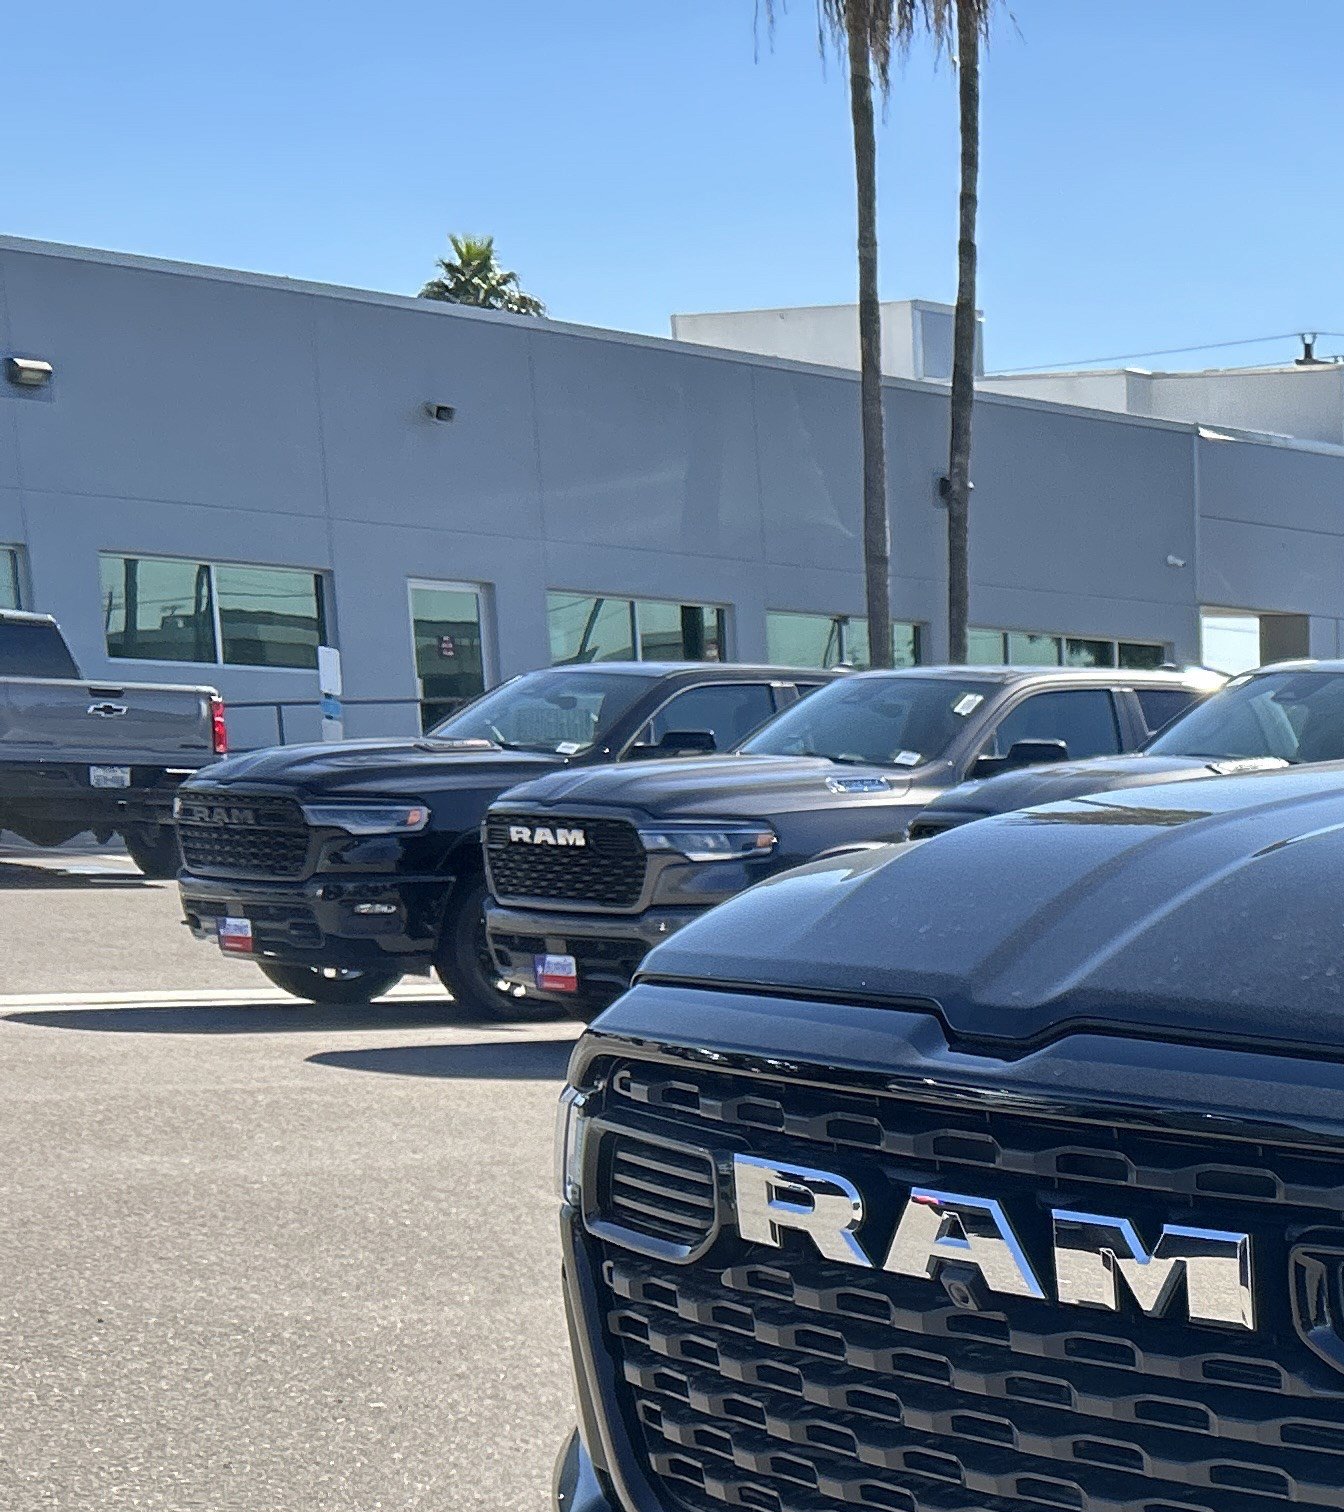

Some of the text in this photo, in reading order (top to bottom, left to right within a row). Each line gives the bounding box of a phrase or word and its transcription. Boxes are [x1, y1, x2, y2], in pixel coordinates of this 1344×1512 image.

[191, 806, 256, 825] RAM
[508, 825, 586, 847] RAM
[734, 1153, 1254, 1331] RAM
